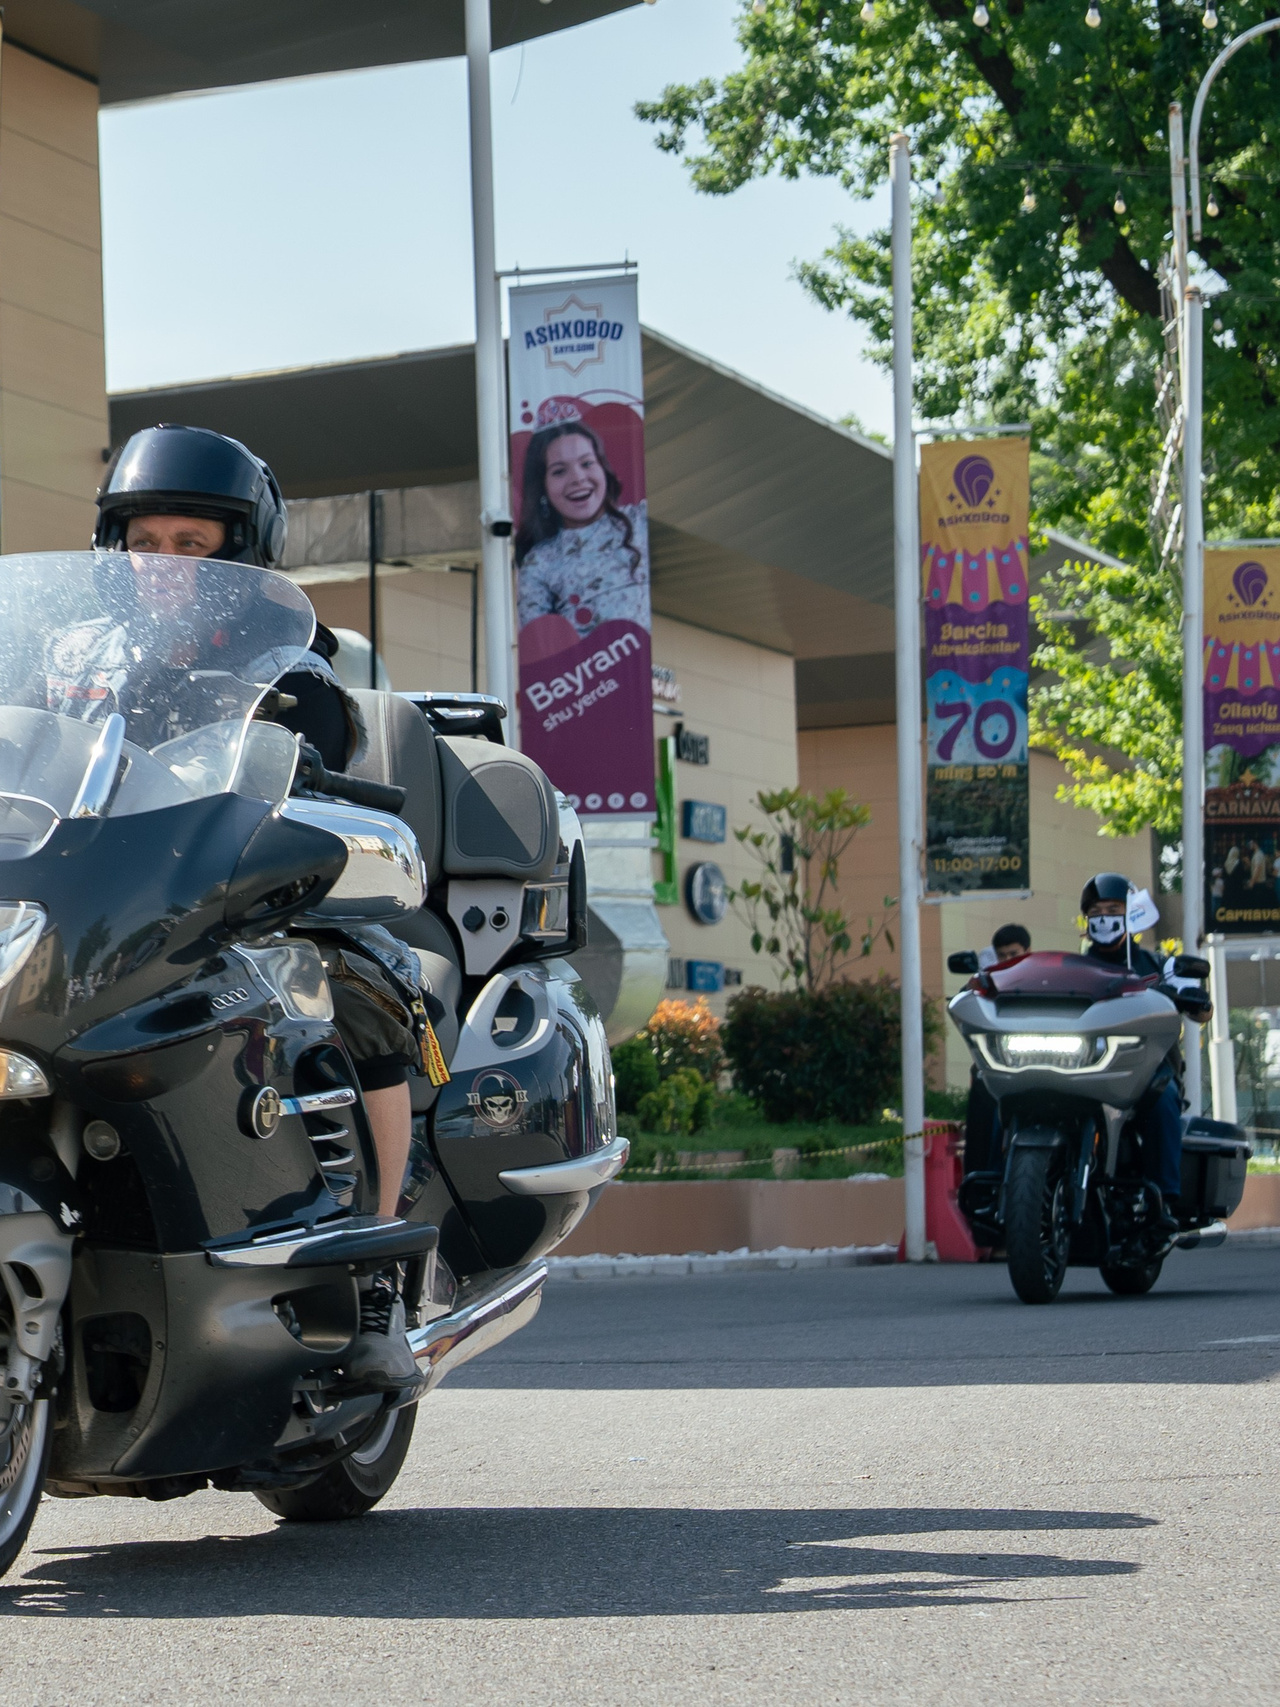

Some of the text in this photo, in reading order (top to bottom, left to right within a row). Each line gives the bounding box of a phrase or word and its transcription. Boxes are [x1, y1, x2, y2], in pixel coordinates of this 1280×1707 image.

[524, 319, 624, 349] ASHXOBOD
[938, 511, 1010, 528] ASHXOBOD
[941, 621, 1009, 641] Barcha
[525, 632, 641, 713] Bayram
[542, 707, 574, 733] shu
[573, 678, 619, 717] yerda
[934, 700, 1017, 761] 70
[934, 764, 974, 782] ming
[1206, 800, 1280, 816] CARNAVA
[934, 855, 1022, 872] 11:00-17:00
[1215, 907, 1280, 922] Carnava
